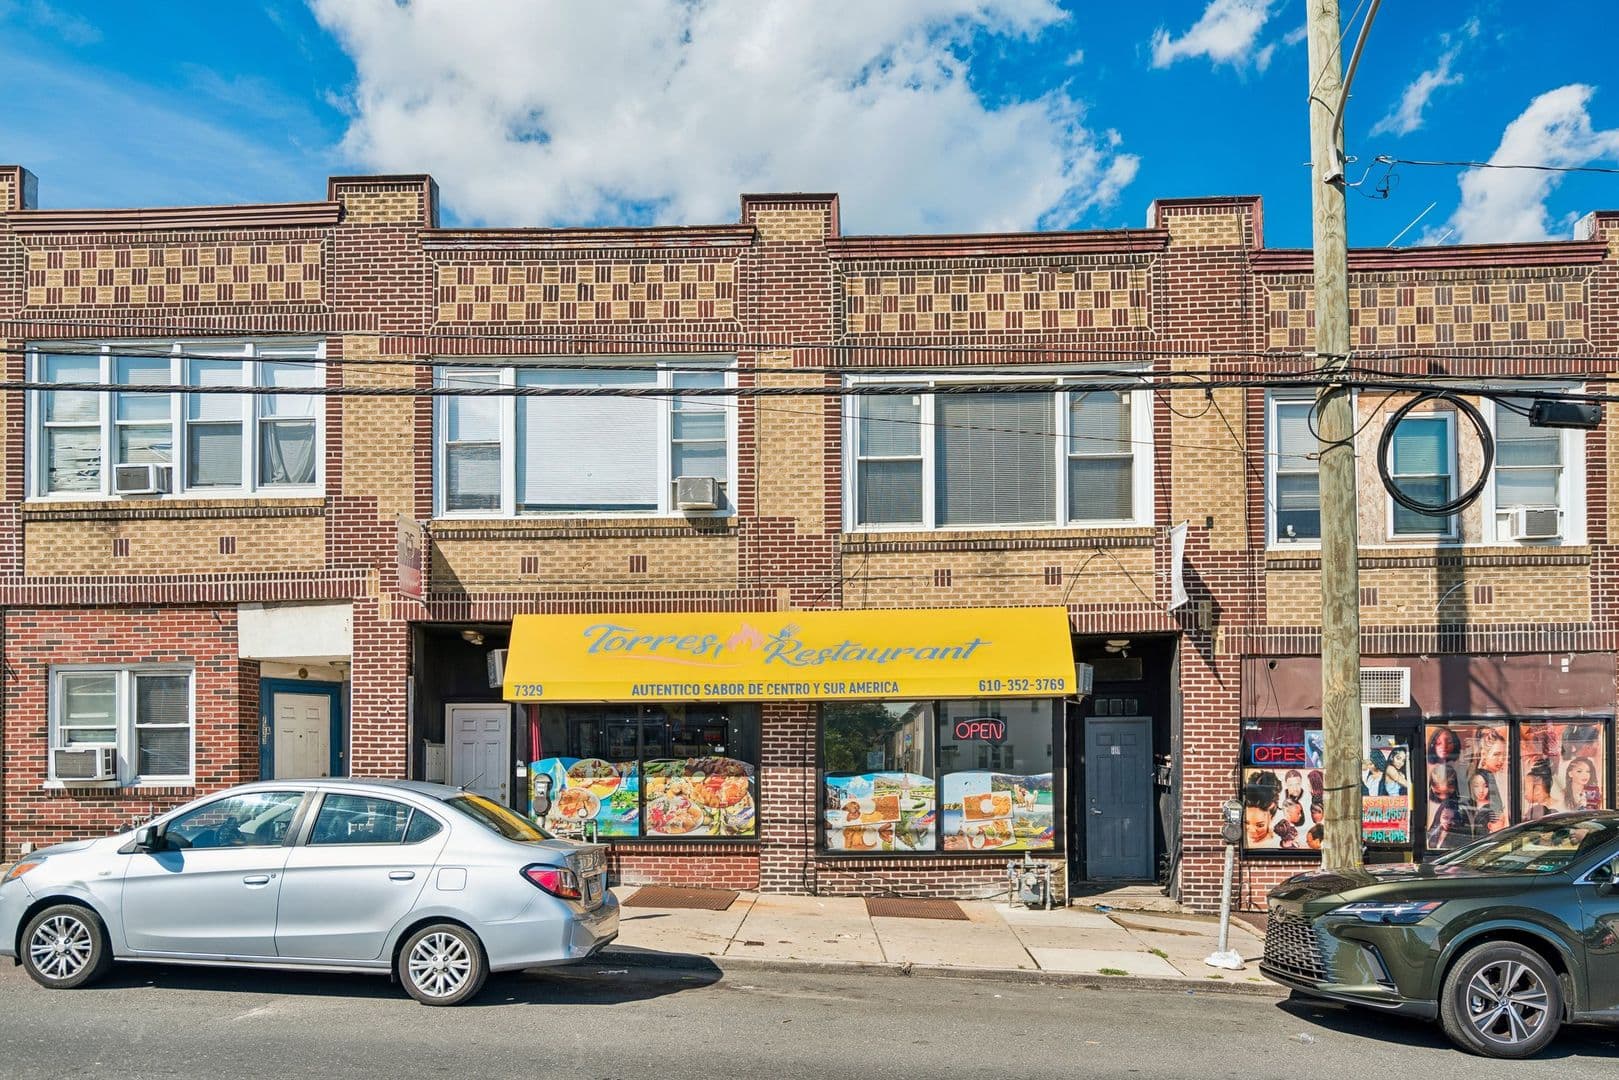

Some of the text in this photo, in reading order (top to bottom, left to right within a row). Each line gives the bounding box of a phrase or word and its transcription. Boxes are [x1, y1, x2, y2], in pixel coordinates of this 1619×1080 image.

[763, 637, 992, 666] Restaurant
[514, 684, 543, 697] 7329
[631, 681, 899, 697] AUTENTICO SABOR DE CENTRO Y SUR AMERICA
[979, 678, 1065, 692] 610-352-3769
[955, 722, 1003, 740] OPEN
